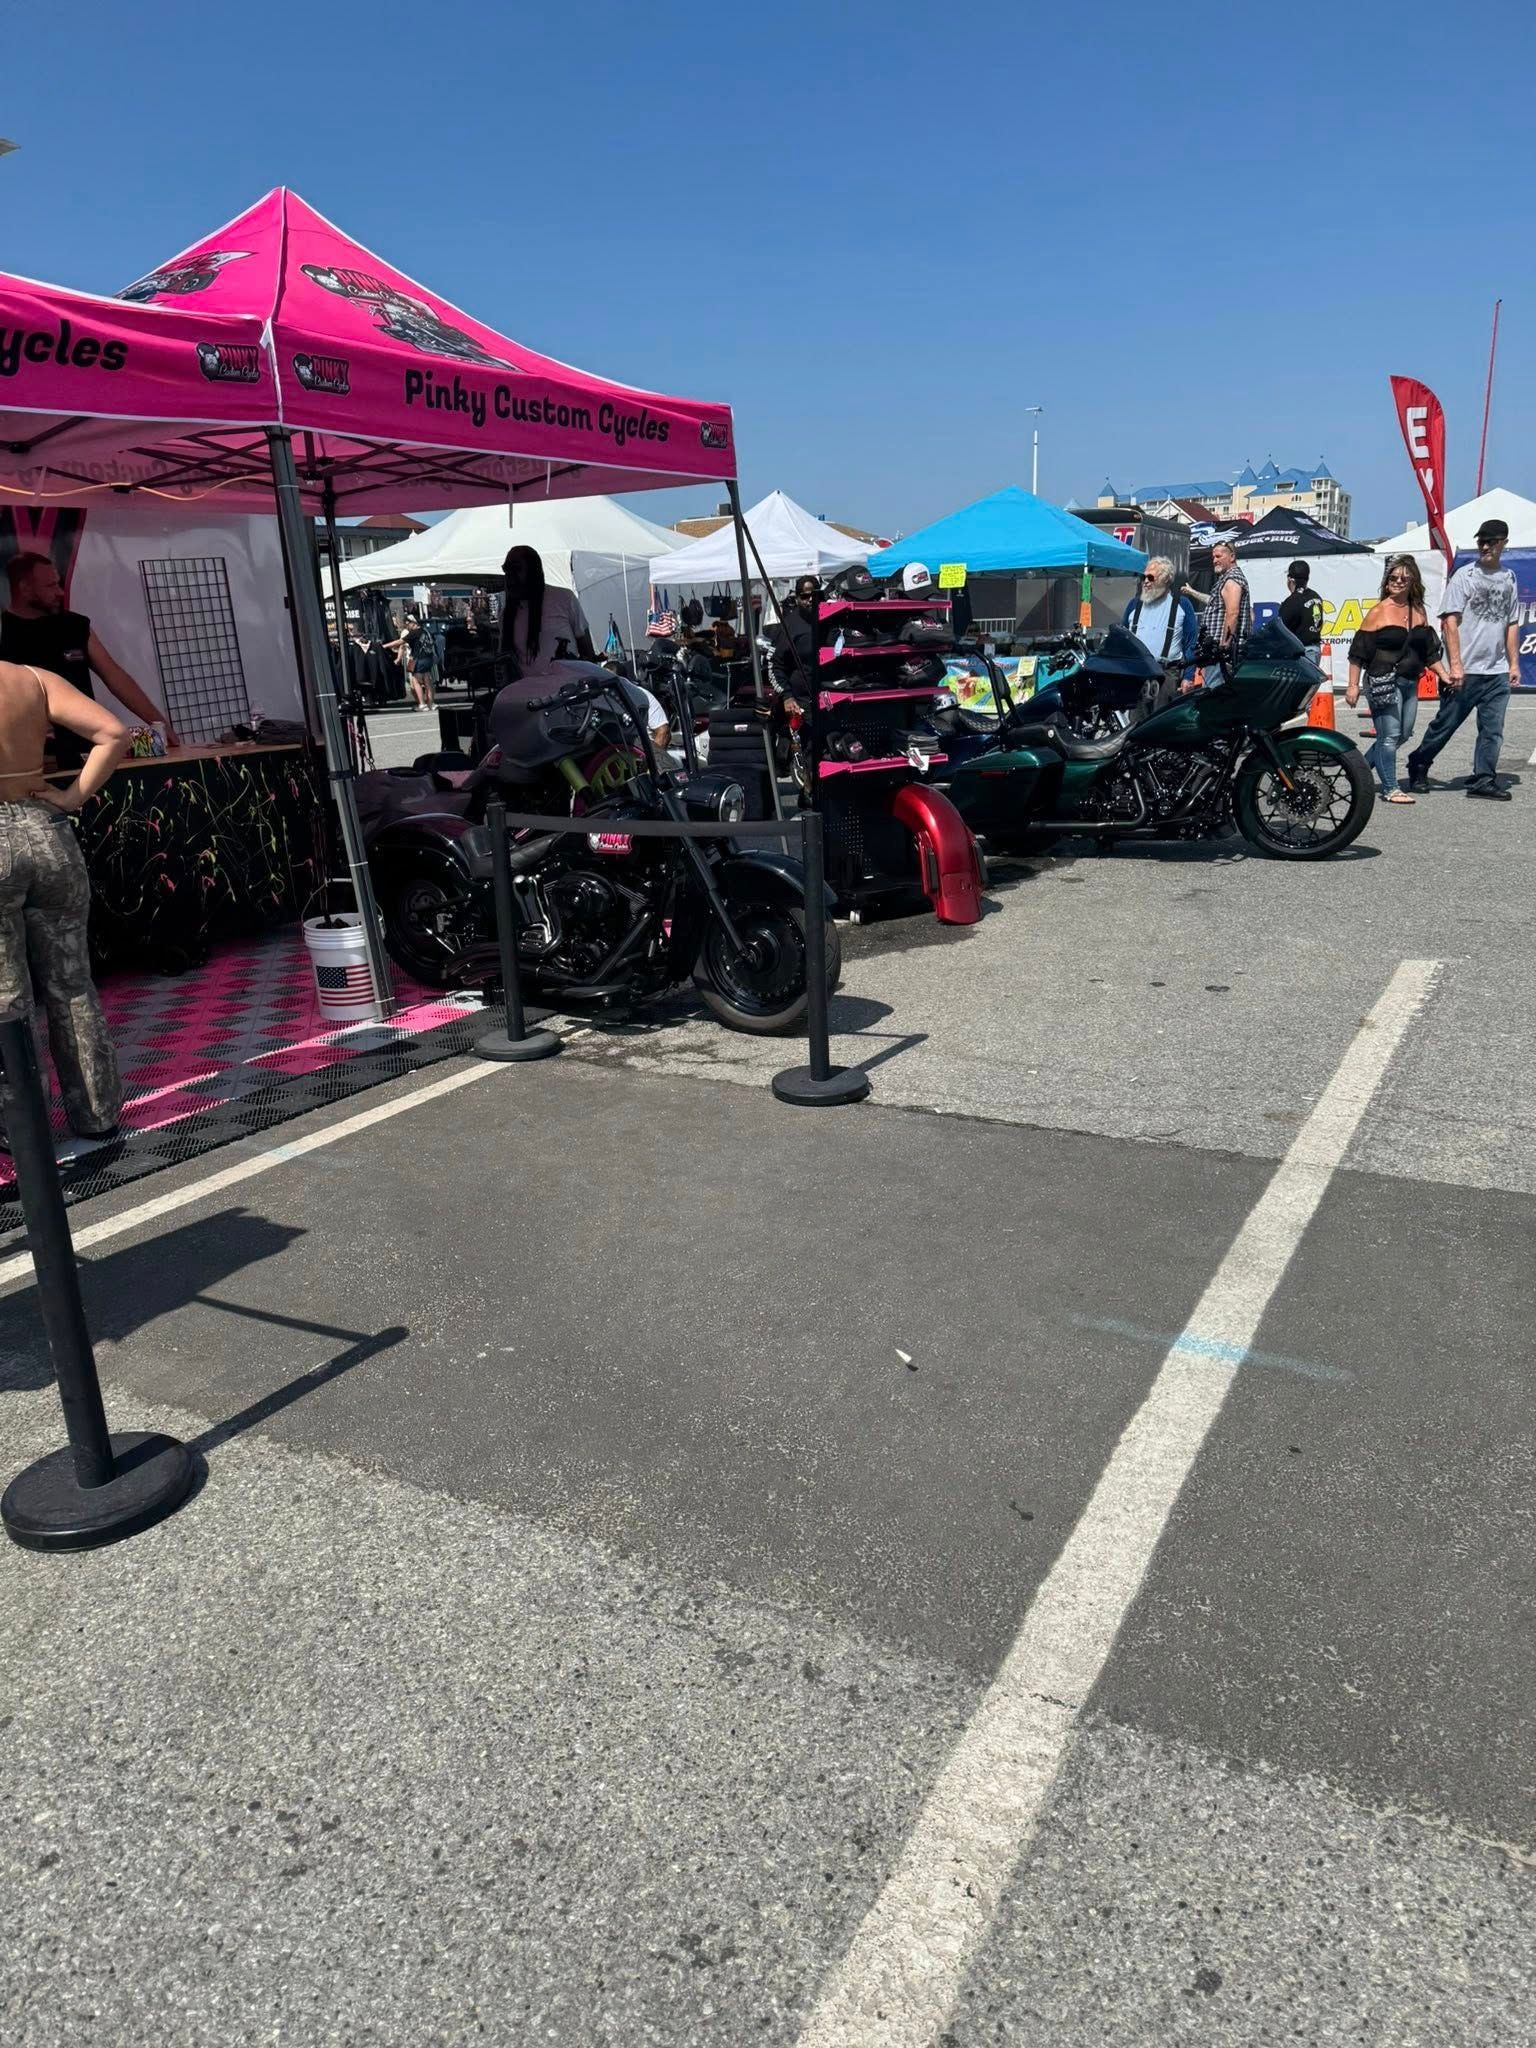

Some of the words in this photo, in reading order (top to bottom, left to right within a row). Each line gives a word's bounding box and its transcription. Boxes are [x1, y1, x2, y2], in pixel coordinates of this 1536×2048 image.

[313, 358, 349, 380] PINKY
[404, 368, 487, 428] Pinky
[495, 384, 594, 432] Custom
[599, 402, 671, 447] Cycles
